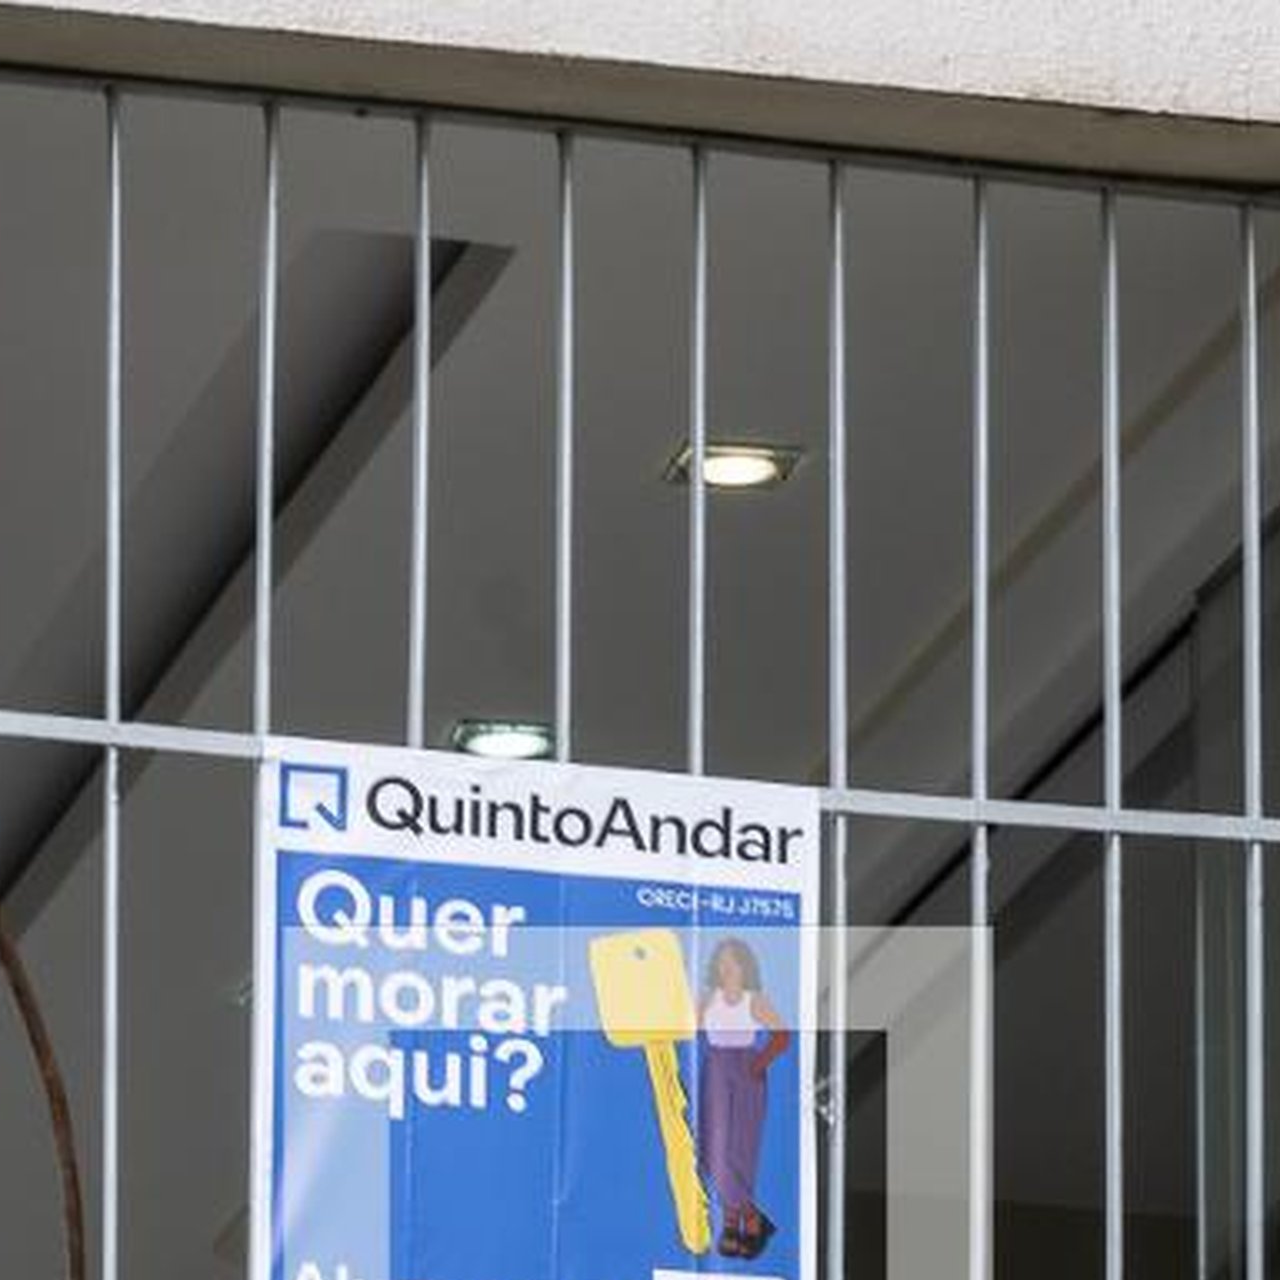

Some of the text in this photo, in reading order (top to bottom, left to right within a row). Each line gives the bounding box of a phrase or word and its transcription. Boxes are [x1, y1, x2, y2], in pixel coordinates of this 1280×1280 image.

[366, 776, 803, 864] QuintoAndar
[296, 869, 525, 956] Quer
[298, 963, 567, 1037] morar
[294, 1038, 544, 1120] aqui?
